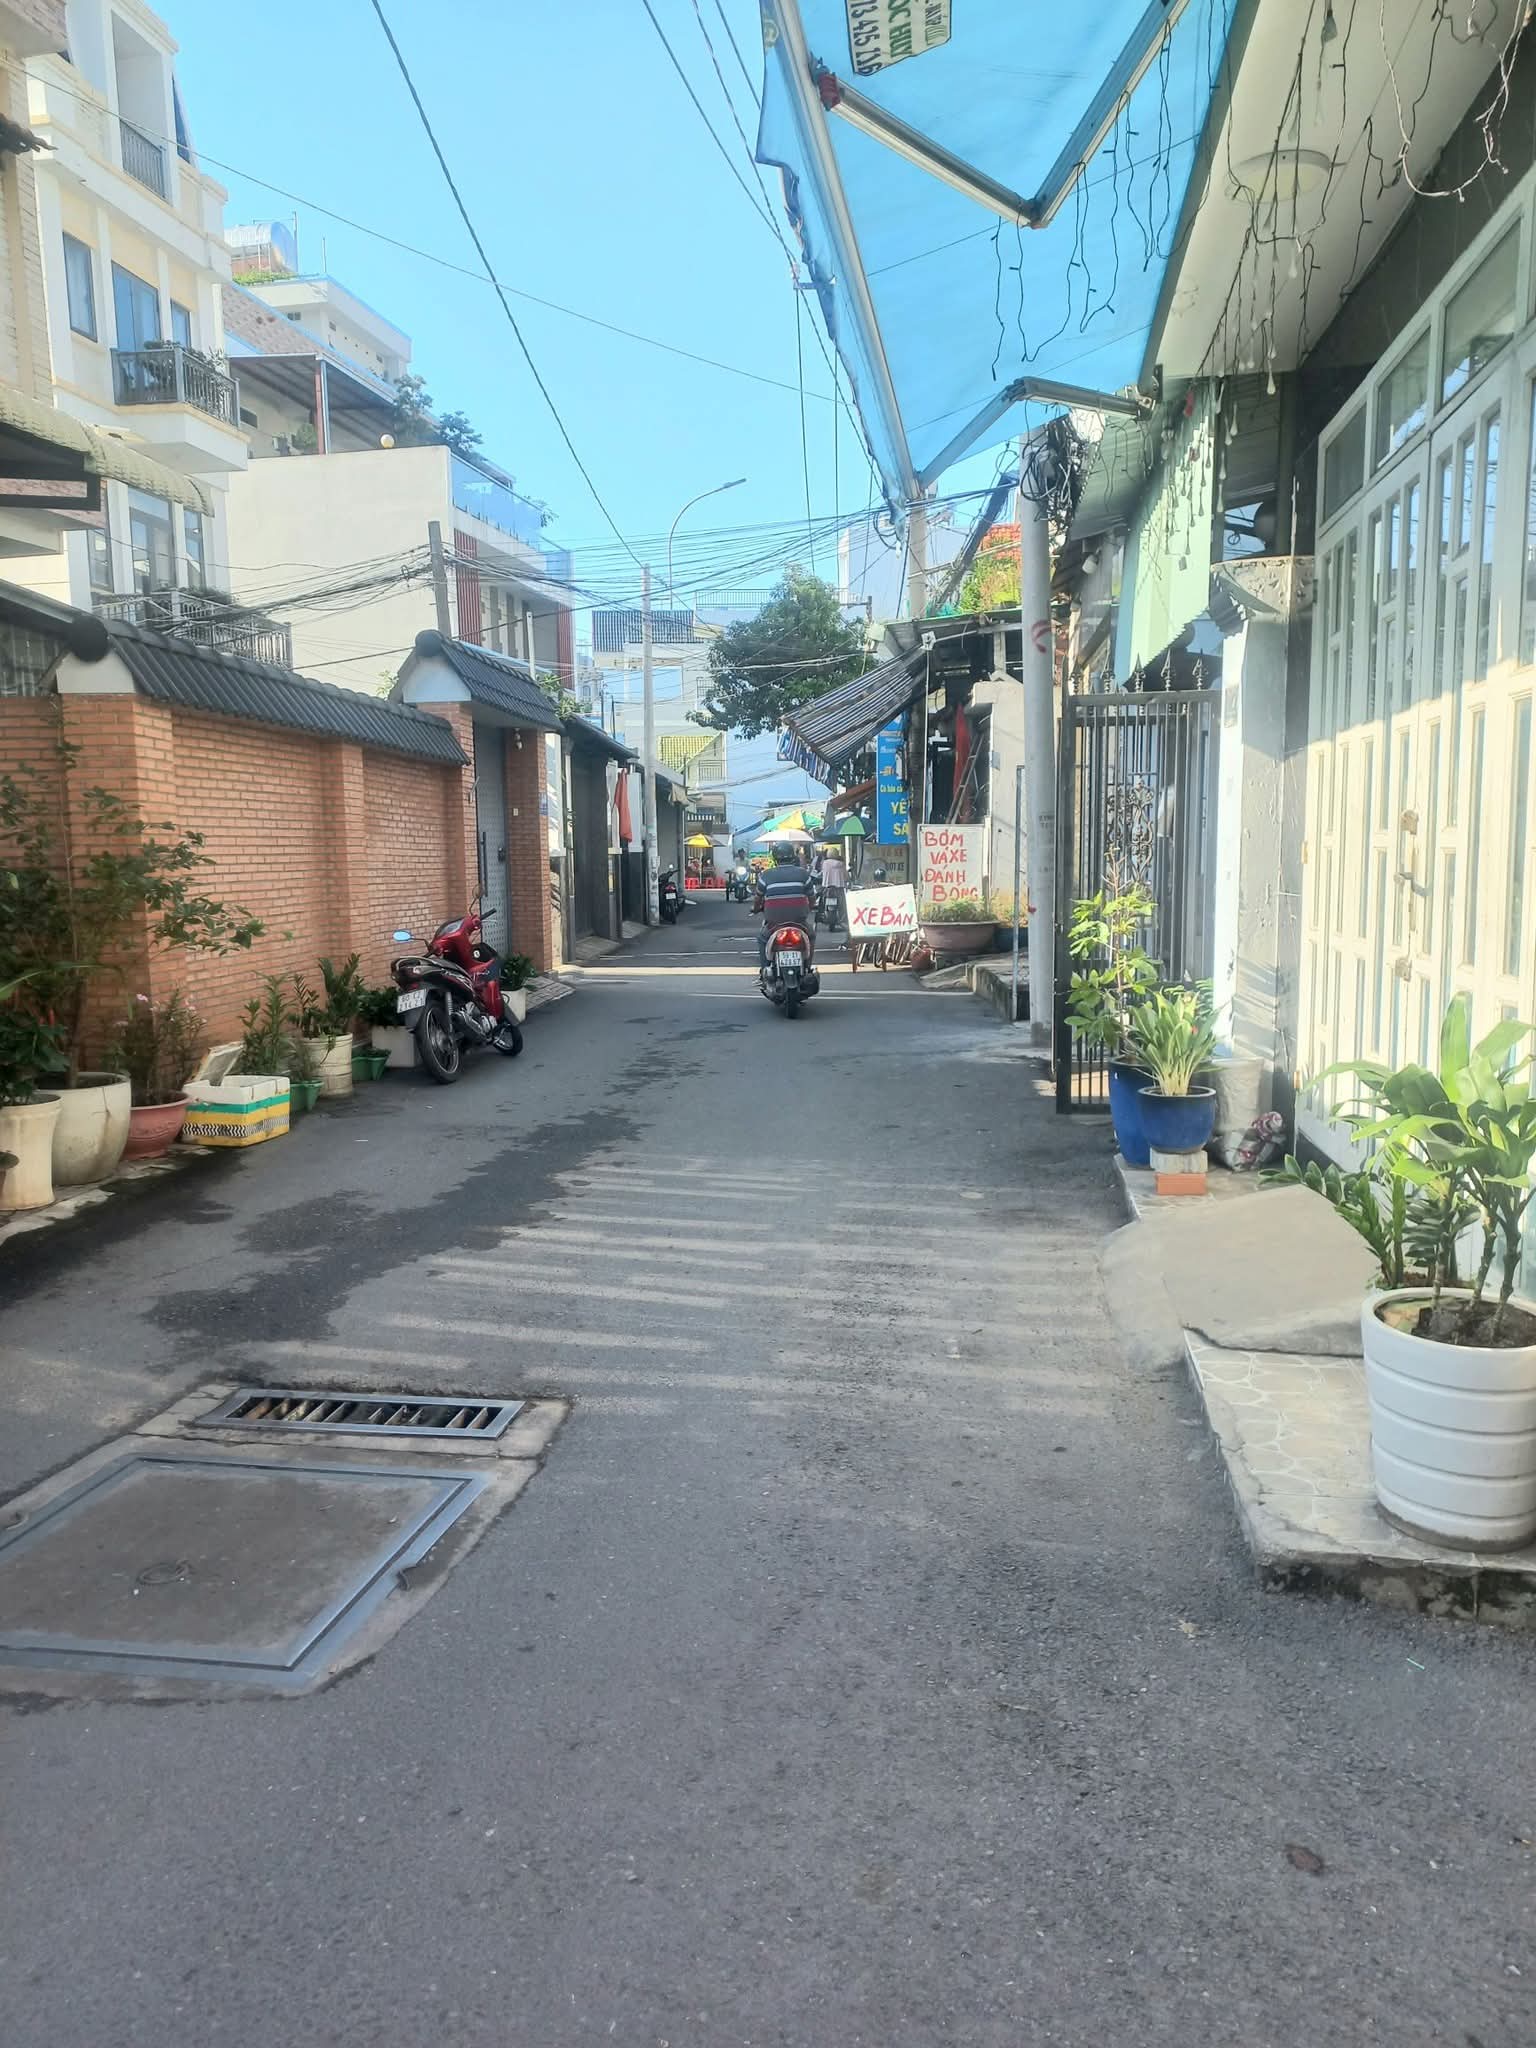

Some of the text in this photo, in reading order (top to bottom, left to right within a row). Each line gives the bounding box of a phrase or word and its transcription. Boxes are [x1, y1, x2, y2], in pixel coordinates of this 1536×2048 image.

[853, 20, 880, 47] 425
[889, 21, 912, 58] HUY
[949, 849, 967, 863] XE
[853, 901, 914, 927] XE BÁN
